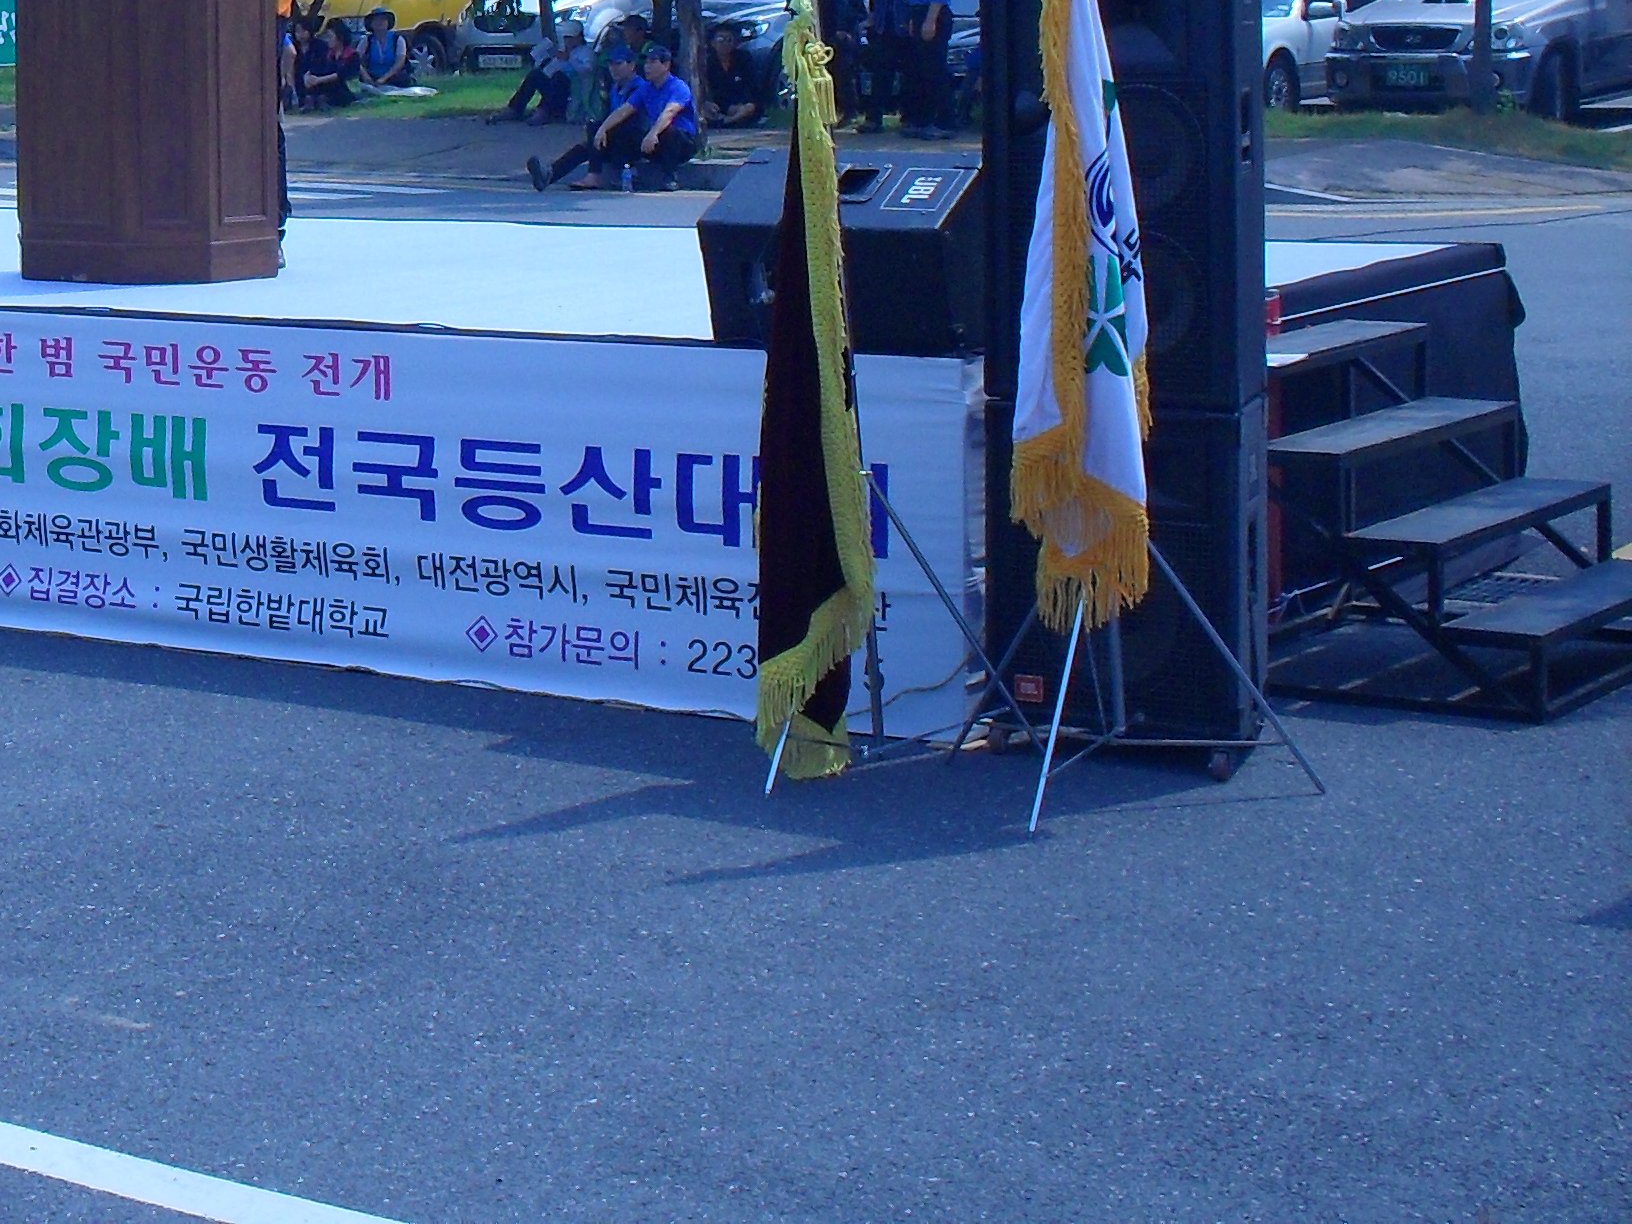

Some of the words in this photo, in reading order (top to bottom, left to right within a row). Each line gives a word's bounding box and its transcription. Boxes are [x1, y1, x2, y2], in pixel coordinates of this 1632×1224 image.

[900, 176, 943, 204] JBL
[40, 335, 75, 378] 범
[98, 340, 278, 395] 국민운동
[301, 351, 392, 402] 전개
[252, 422, 889, 559] 전국등산대
[180, 527, 401, 587] 국민생활체육회,
[417, 552, 590, 606] 대전광역시,
[25, 566, 137, 611] 집결장소
[174, 583, 389, 639] 국립한밭대학교
[504, 617, 640, 670] 참가문의
